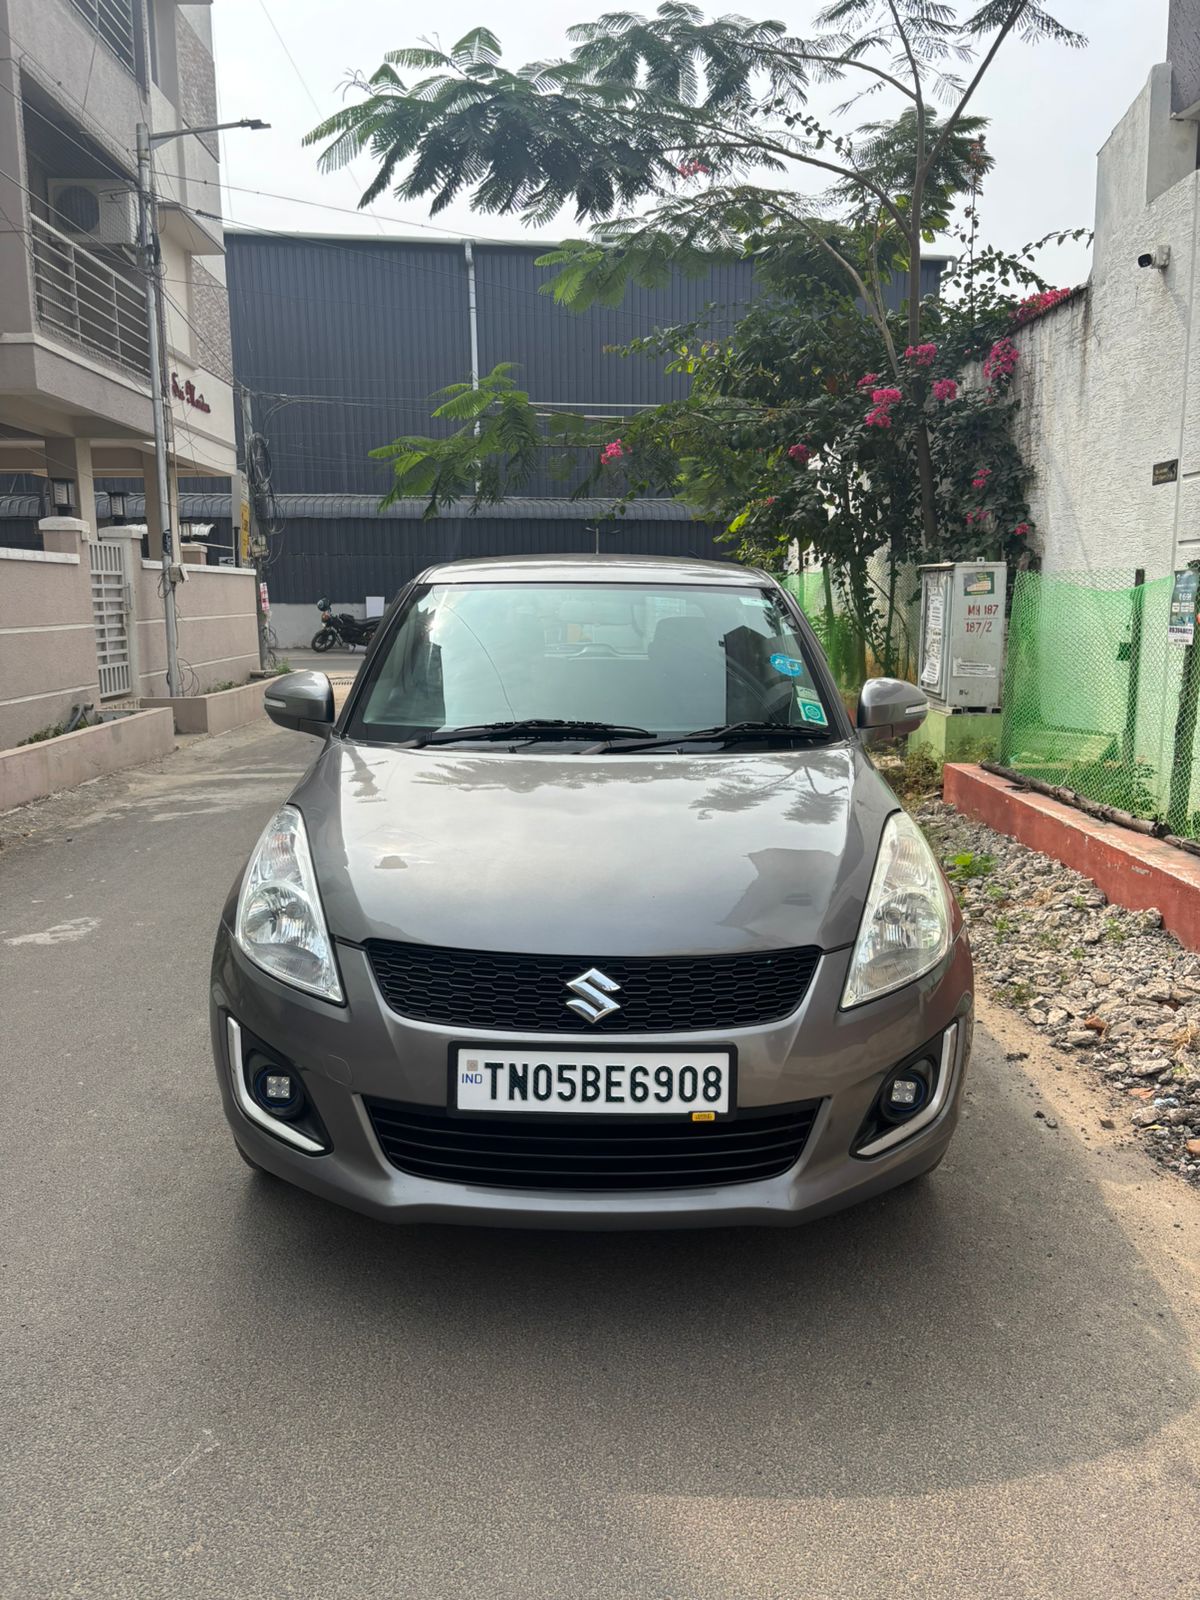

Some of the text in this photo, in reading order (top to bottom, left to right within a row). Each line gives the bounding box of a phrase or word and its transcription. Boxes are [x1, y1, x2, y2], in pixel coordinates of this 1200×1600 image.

[984, 604, 999, 616] 187
[966, 621, 992, 639] 187/2
[461, 1062, 723, 1103] IND TN05BE6908
